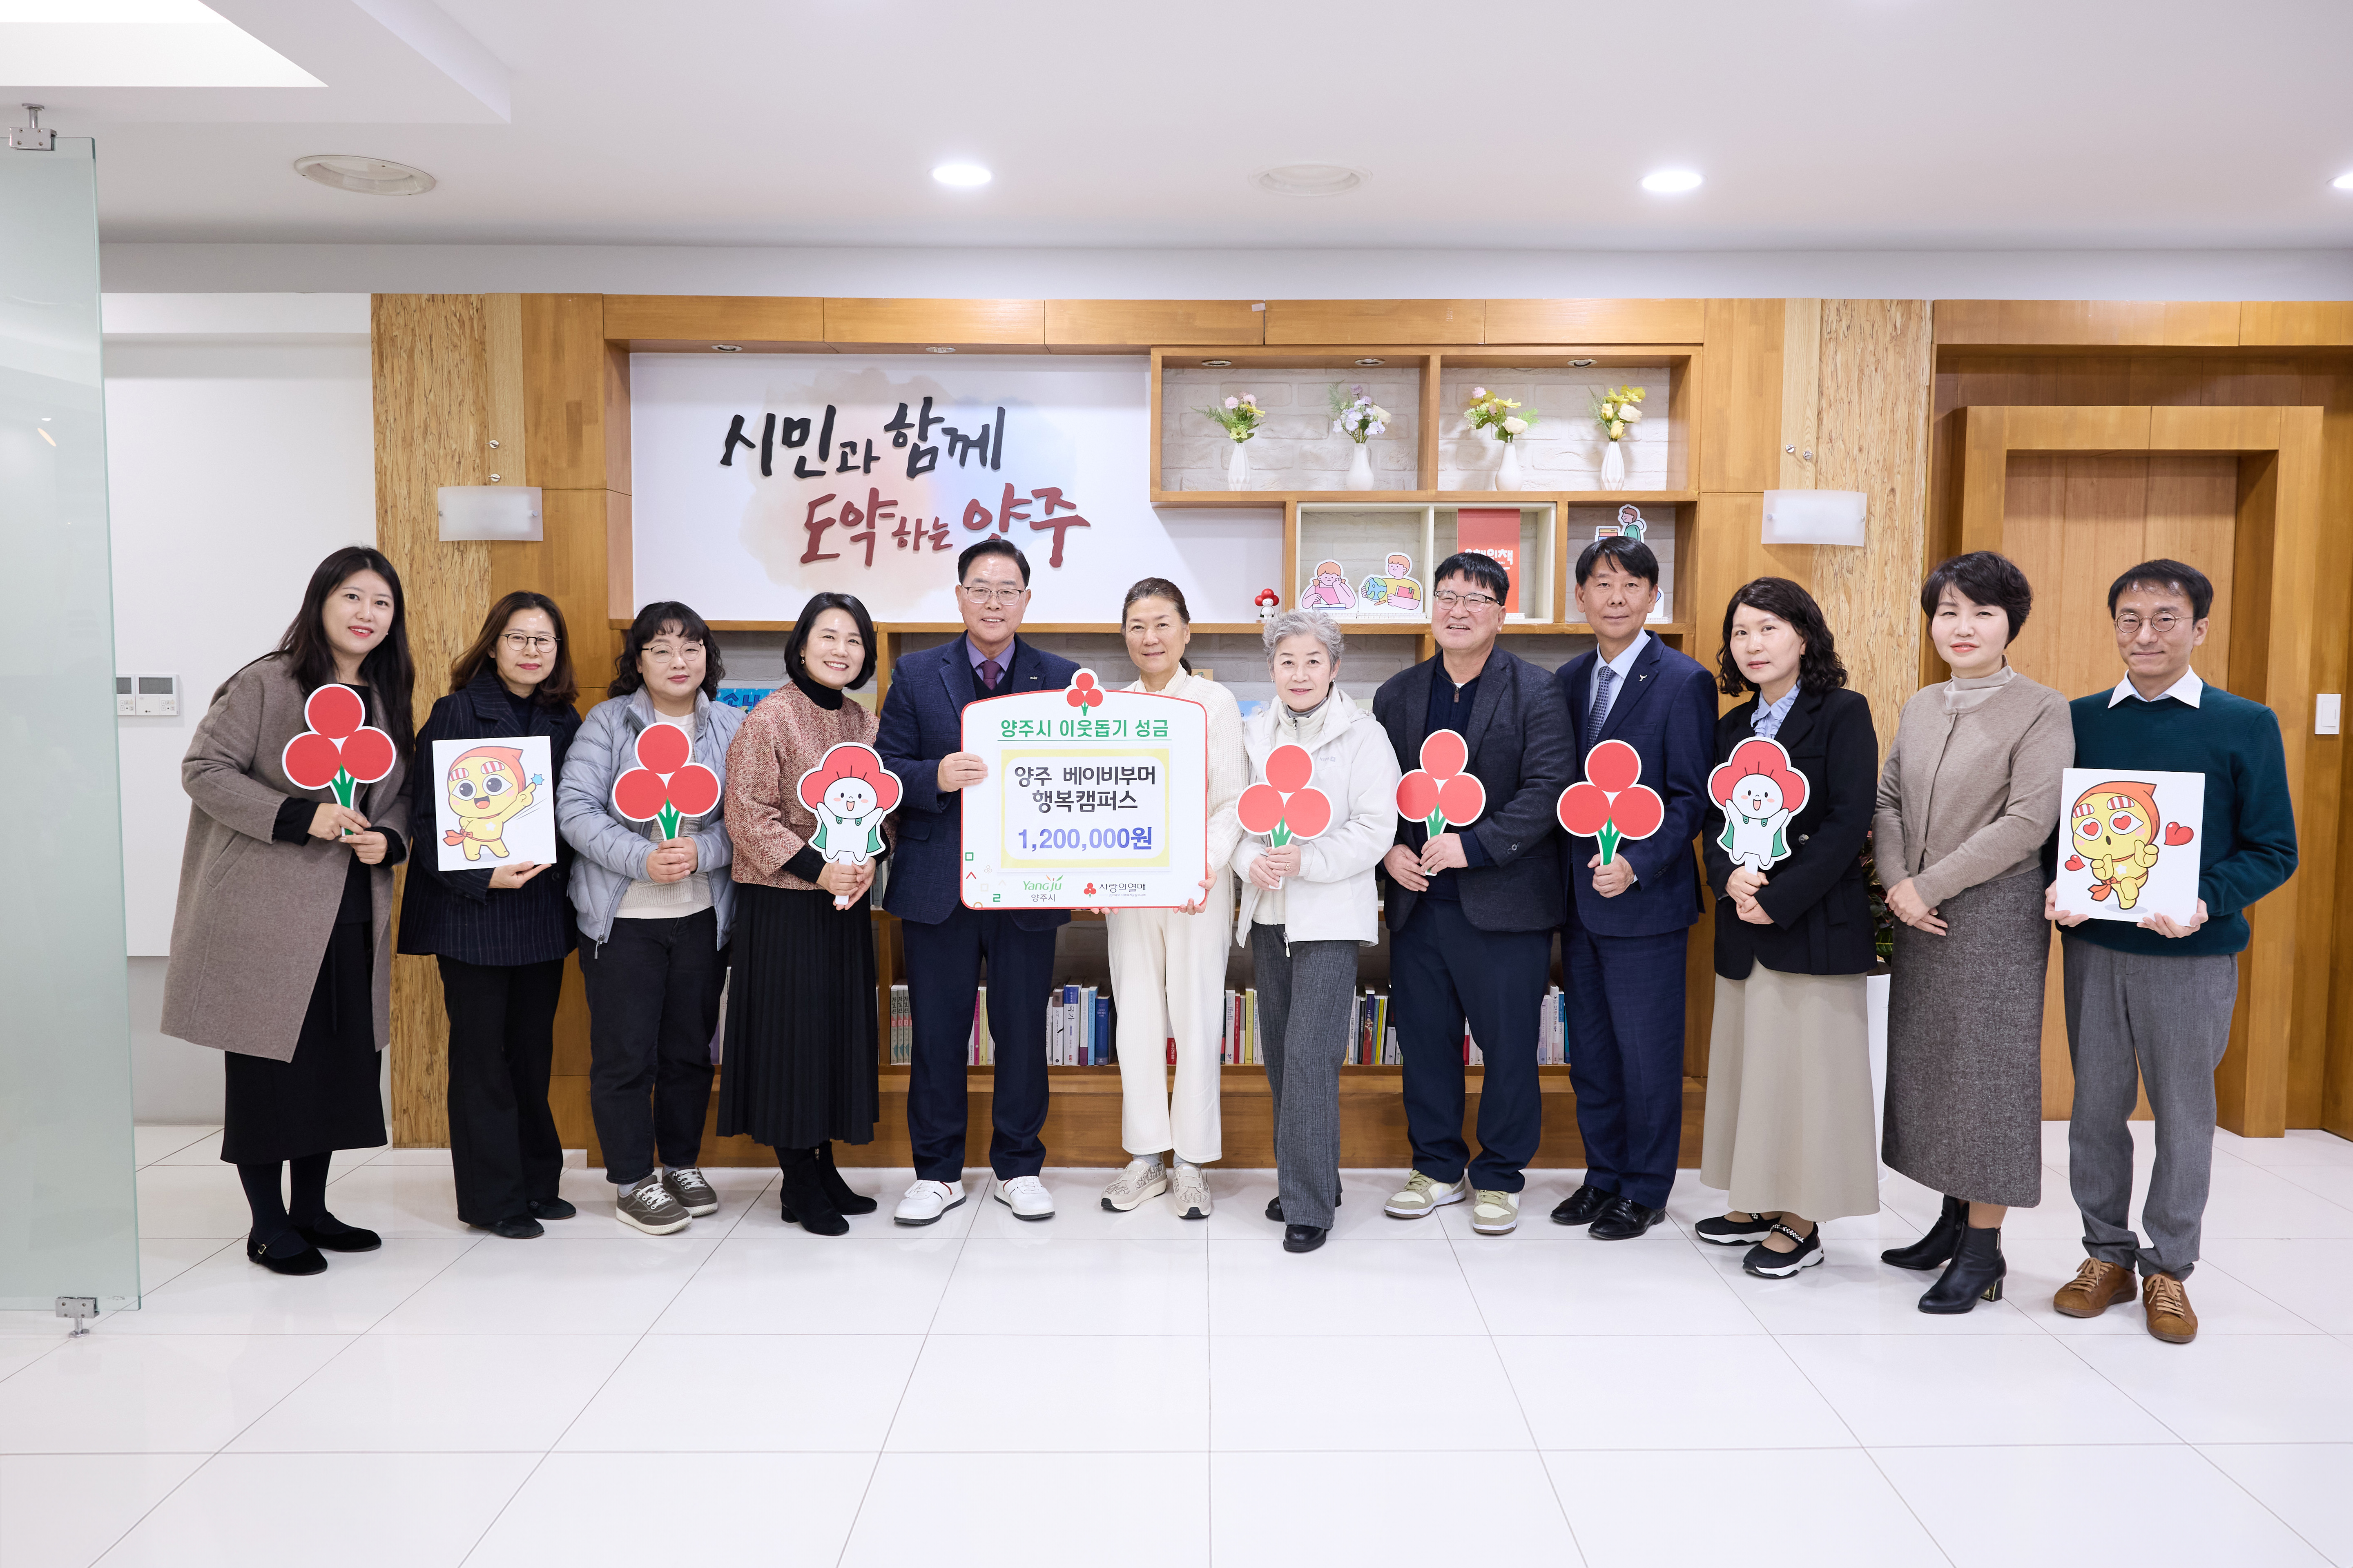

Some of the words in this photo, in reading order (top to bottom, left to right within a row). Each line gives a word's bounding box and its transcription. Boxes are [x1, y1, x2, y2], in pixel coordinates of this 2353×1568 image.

[720, 404, 881, 479] 시민과
[884, 396, 1006, 479] 함께
[800, 487, 953, 567] 도약하는
[963, 483, 1090, 568] 양주
[1001, 720, 1051, 737] 양주시
[1060, 720, 1127, 737] 이웃돕기
[1135, 720, 1169, 737] 성금
[1015, 766, 1053, 788] 양주
[1064, 766, 1155, 786] 베이비부머
[1032, 789, 1138, 813] 행복캠퍼스
[1018, 826, 1153, 852] 1,200,000원
[1031, 894, 1056, 902] 양주시
[1099, 883, 1146, 893] 사랑의열매
